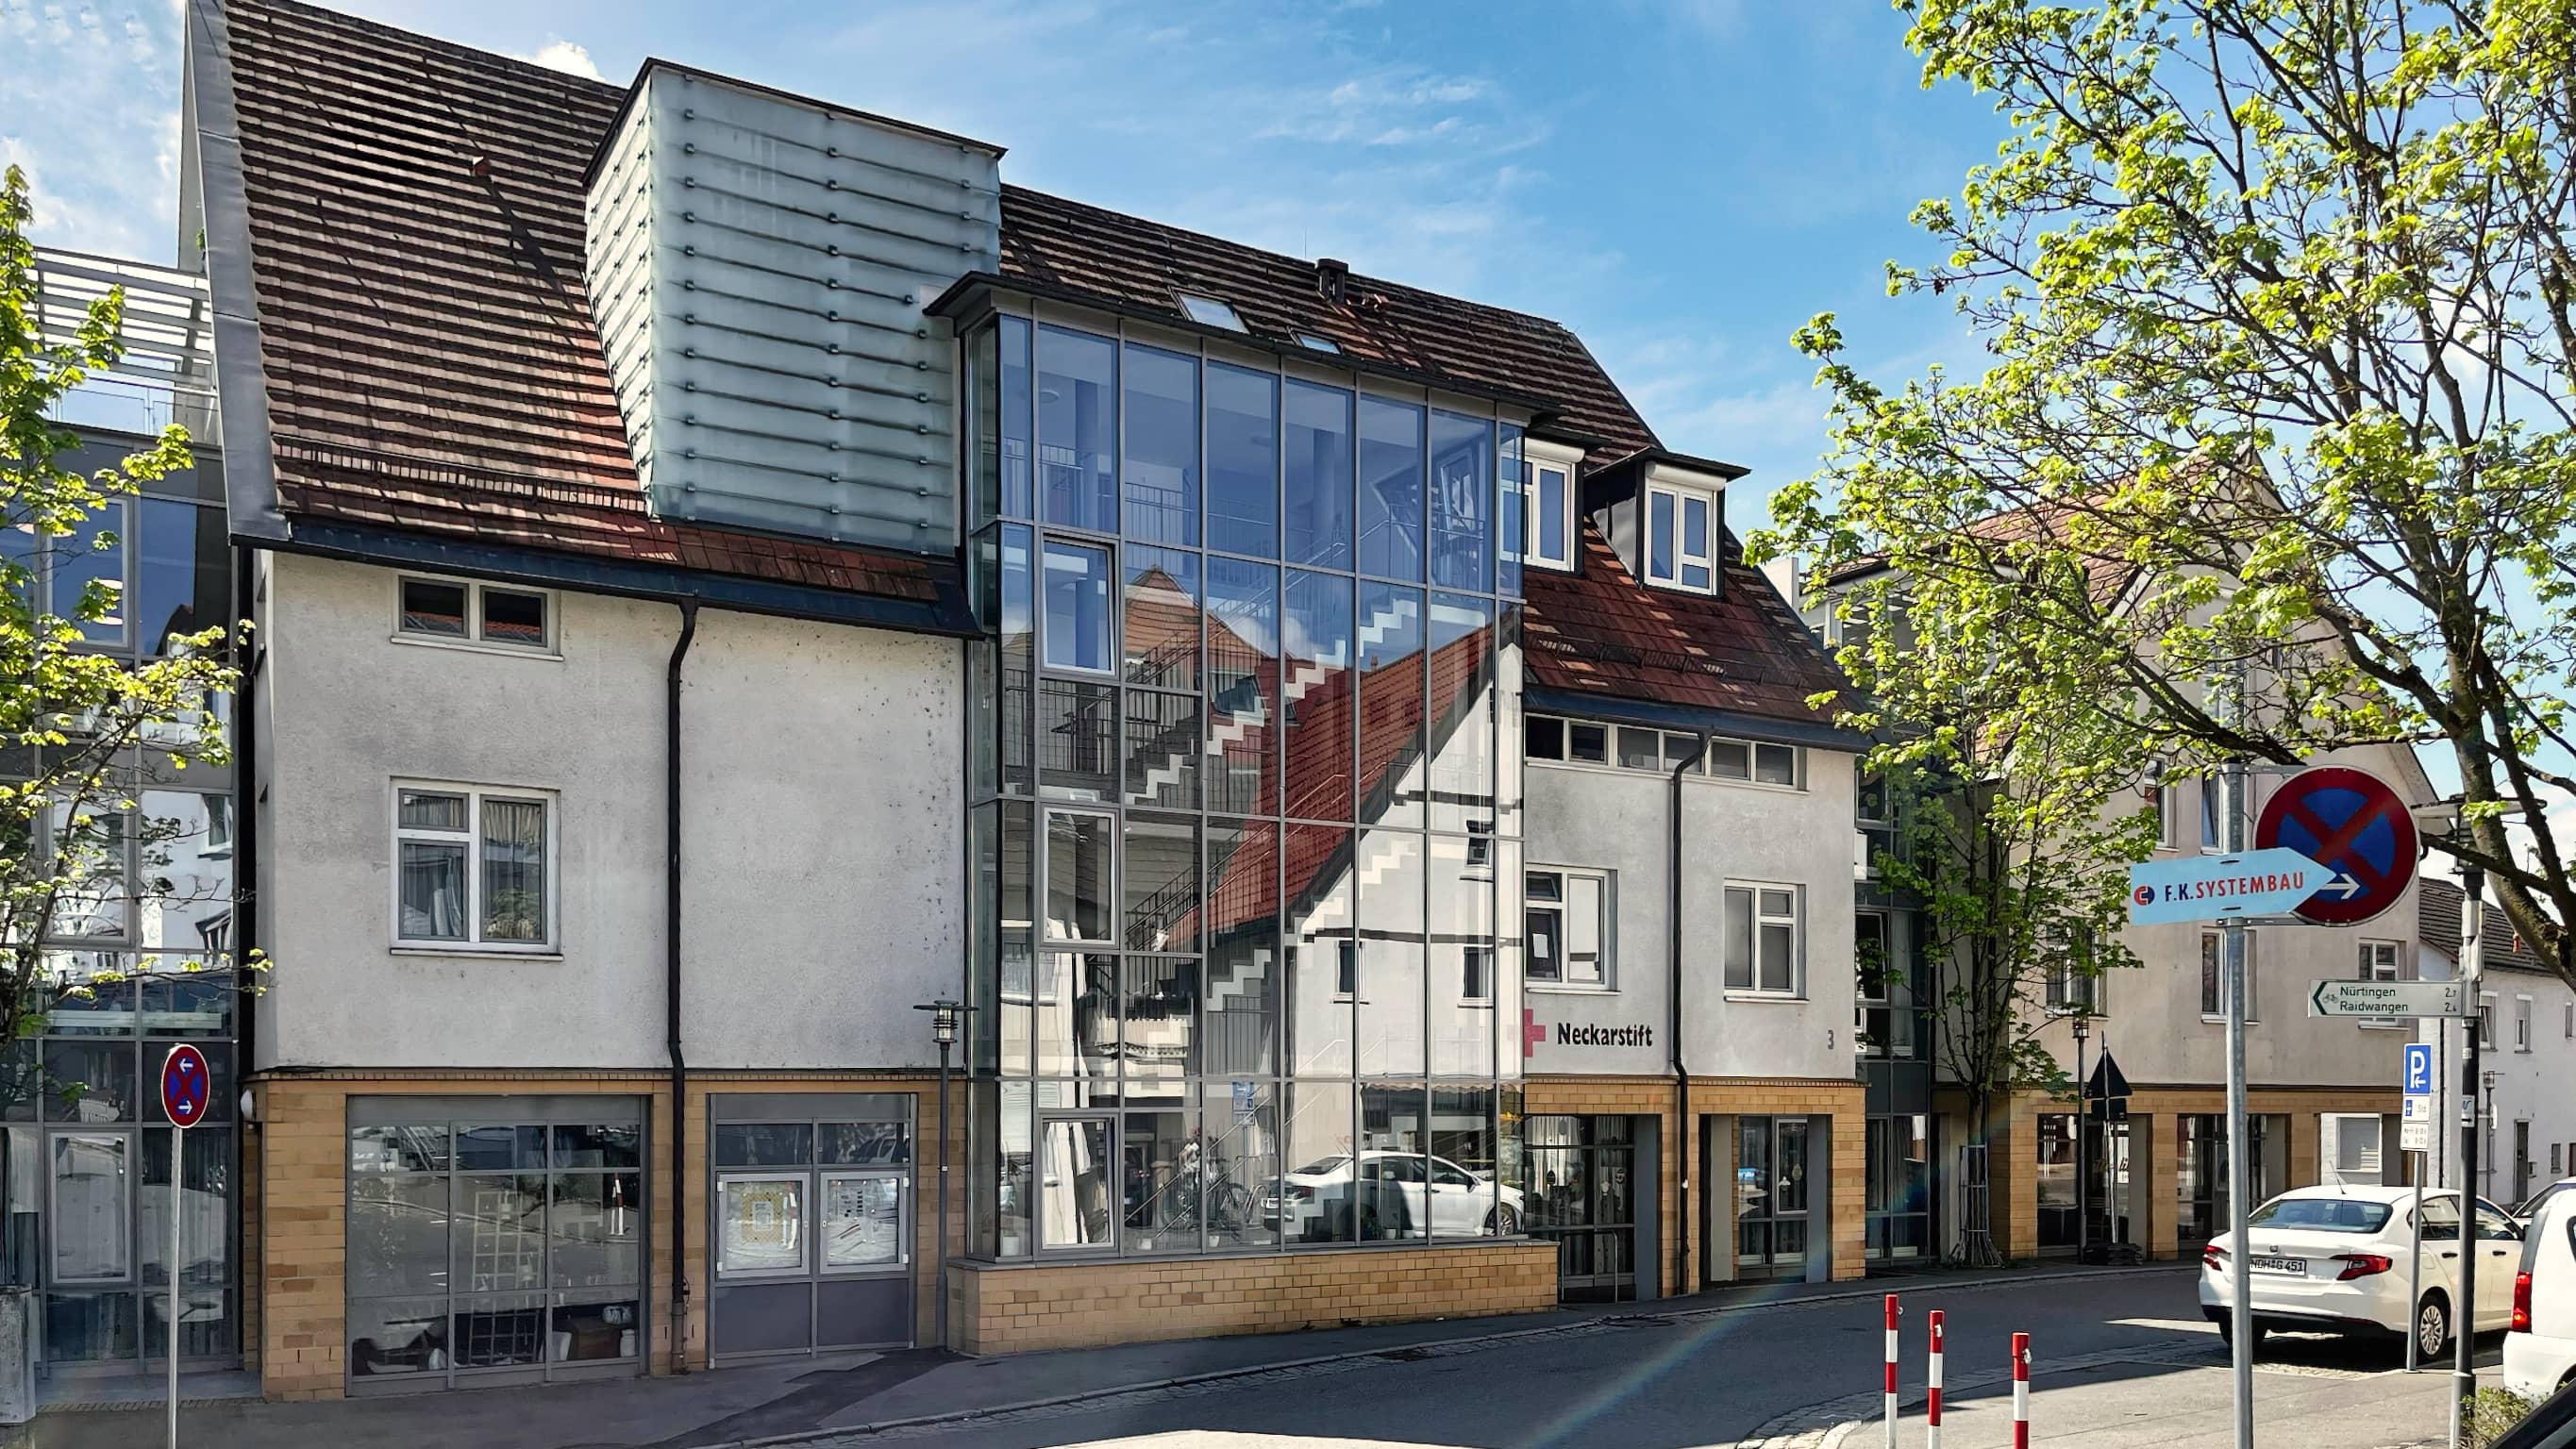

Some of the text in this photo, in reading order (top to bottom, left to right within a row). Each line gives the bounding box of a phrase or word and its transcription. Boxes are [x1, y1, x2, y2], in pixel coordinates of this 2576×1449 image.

[2340, 986, 2396, 999] Nürtingen
[2340, 1000, 2408, 1012] Raidwangen
[1557, 1023, 1653, 1047] Neckarstift
[1827, 1029, 1834, 1050] 3
[2410, 1050, 2426, 1089] P
[2284, 1261, 2303, 1272] 451
